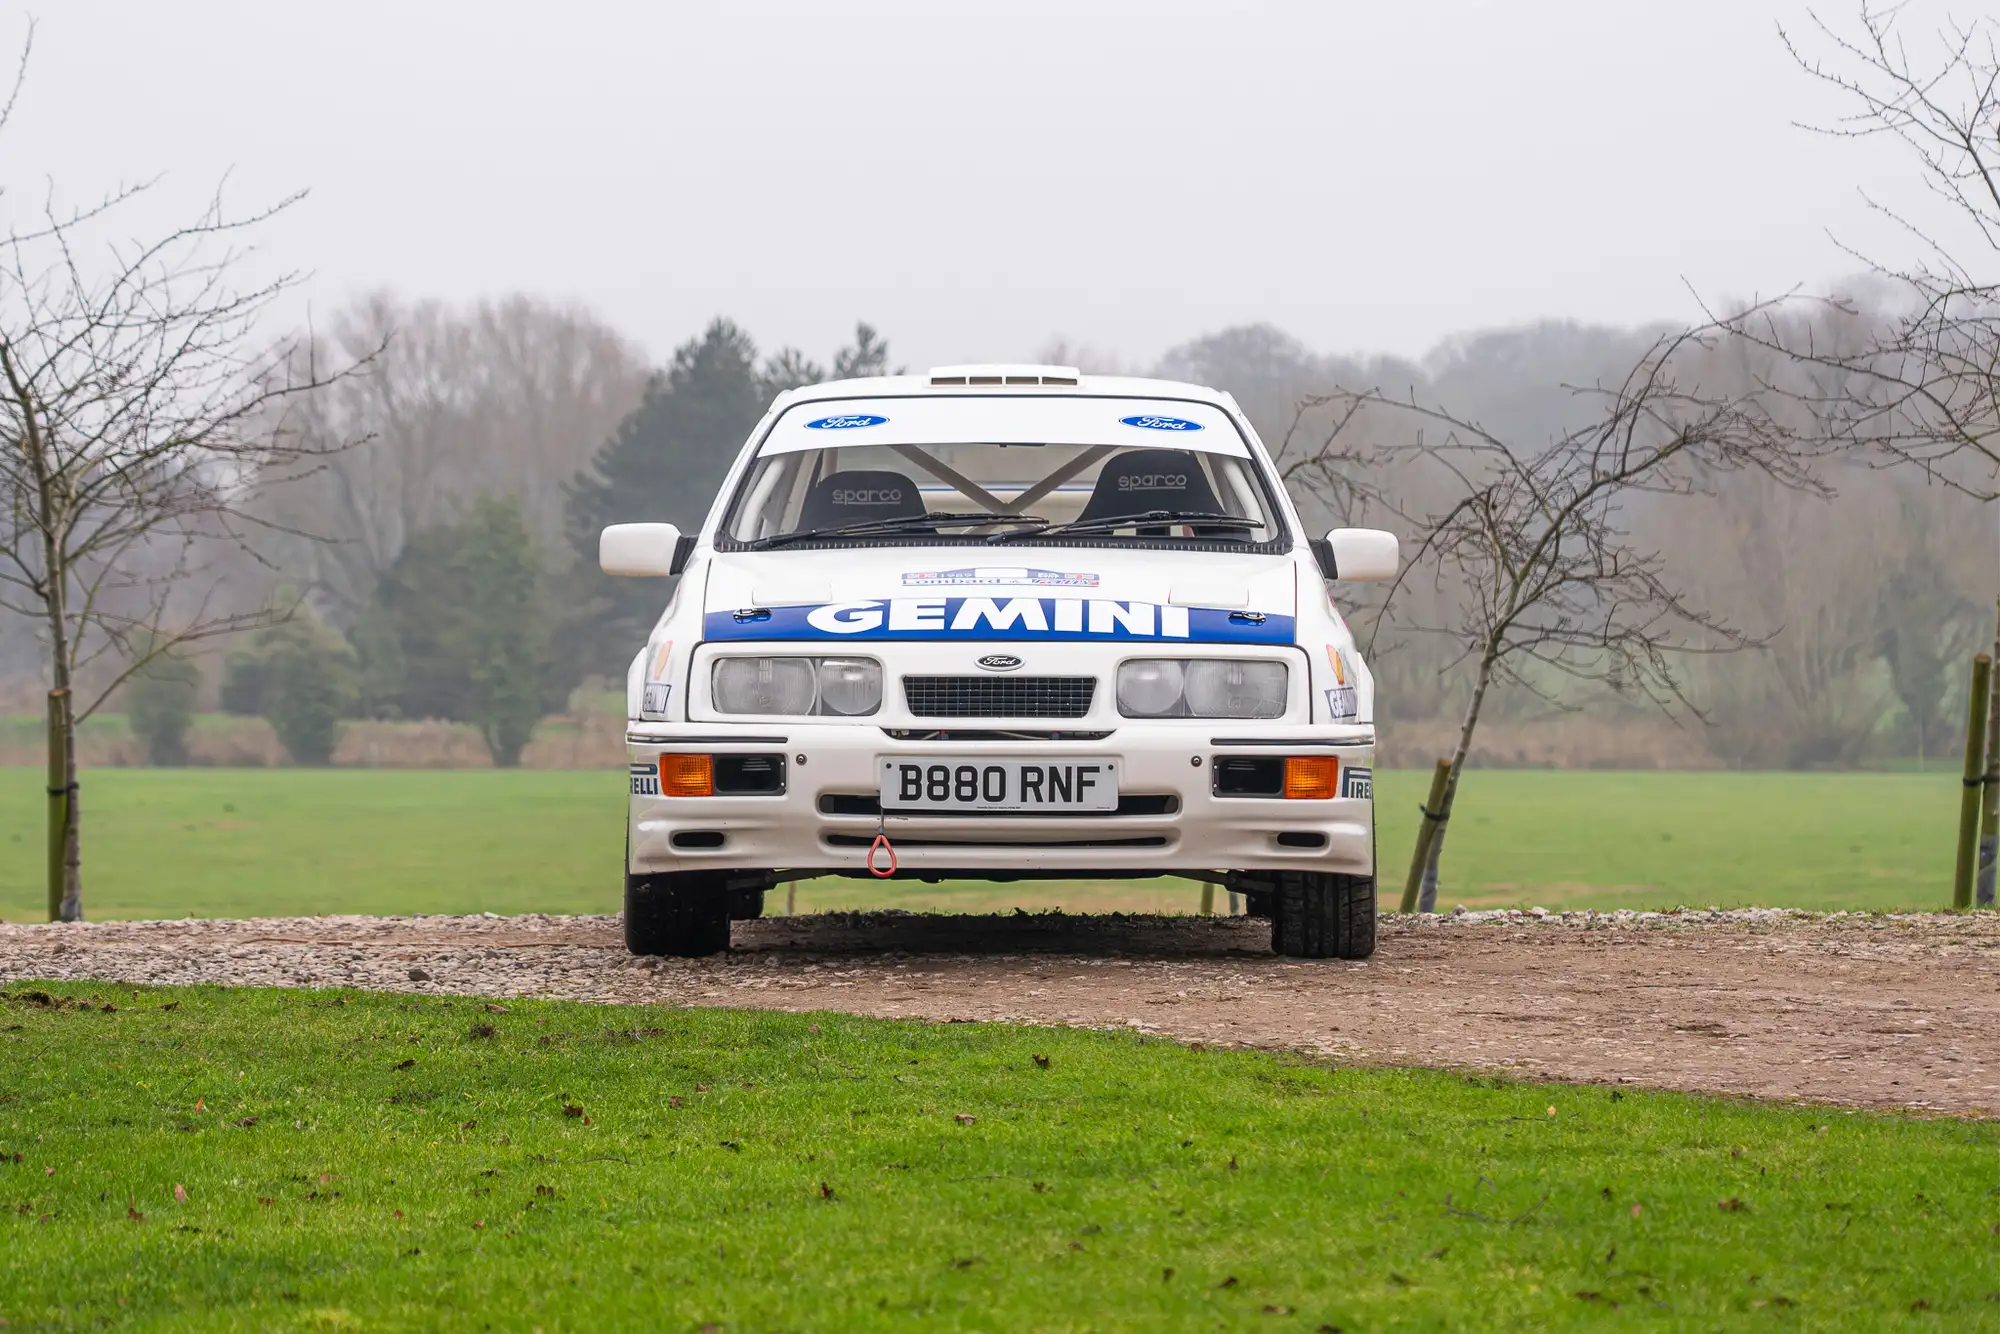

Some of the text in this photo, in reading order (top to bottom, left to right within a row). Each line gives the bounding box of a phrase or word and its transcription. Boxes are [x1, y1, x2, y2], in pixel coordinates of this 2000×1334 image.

[821, 415, 872, 428] Ford
[1136, 416, 1187, 430] Ford
[1118, 474, 1187, 492] sparco
[832, 489, 902, 505] sparco
[806, 597, 1190, 638] GEMINI
[899, 764, 1101, 803] B880 RNF
